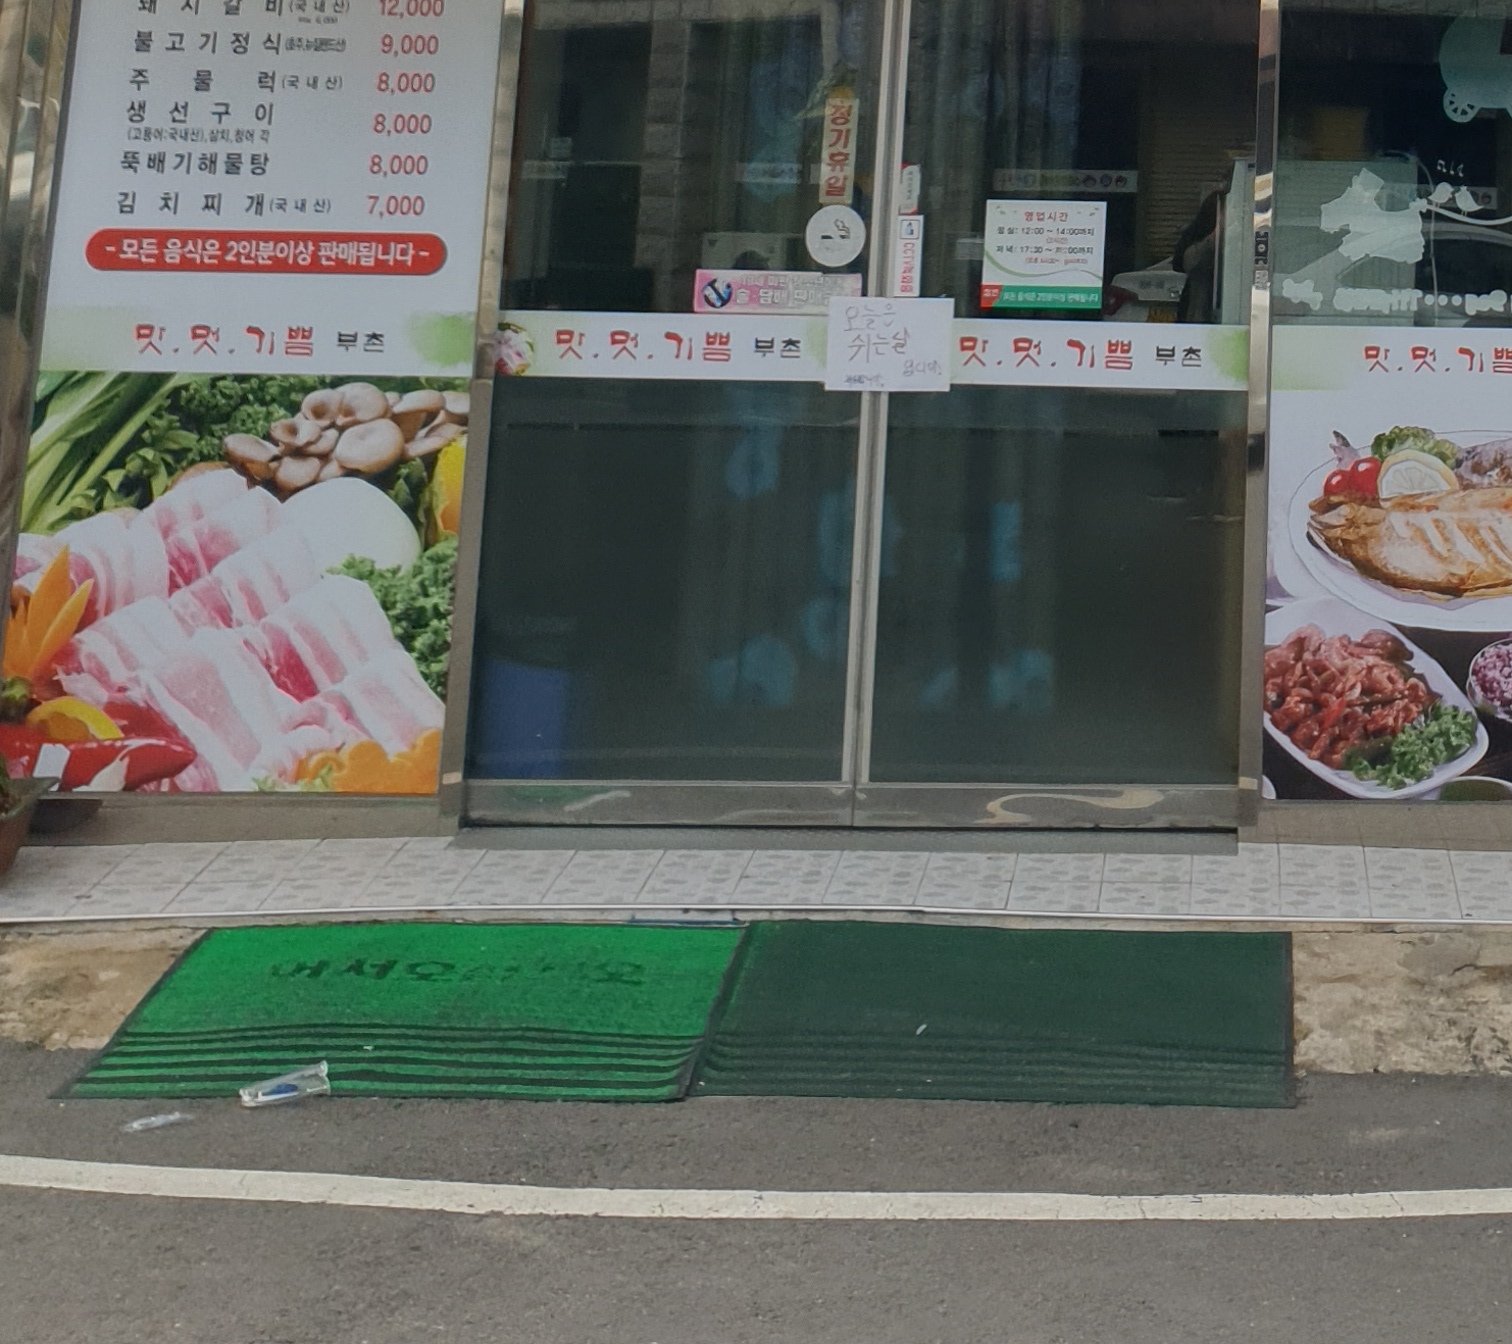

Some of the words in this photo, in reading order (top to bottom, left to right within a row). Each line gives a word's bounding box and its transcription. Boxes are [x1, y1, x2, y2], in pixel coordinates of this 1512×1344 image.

[381, 34, 439, 56] 9,000
[377, 72, 435, 94] 8,000
[373, 113, 432, 136] 8,000
[825, 104, 852, 197] 정기휴일
[121, 151, 269, 175] 뚝배기해물탕
[369, 154, 428, 176] 8,000
[367, 195, 426, 218] 7,000
[119, 238, 160, 261] 모든
[164, 239, 221, 263] 음식은
[225, 240, 314, 265] 2인분이상
[318, 241, 415, 266] 판매됩니다
[843, 303, 897, 331] 오늘은
[337, 330, 385, 353] 부촌
[754, 337, 802, 358] 부촌
[1155, 344, 1203, 367] 부촌
